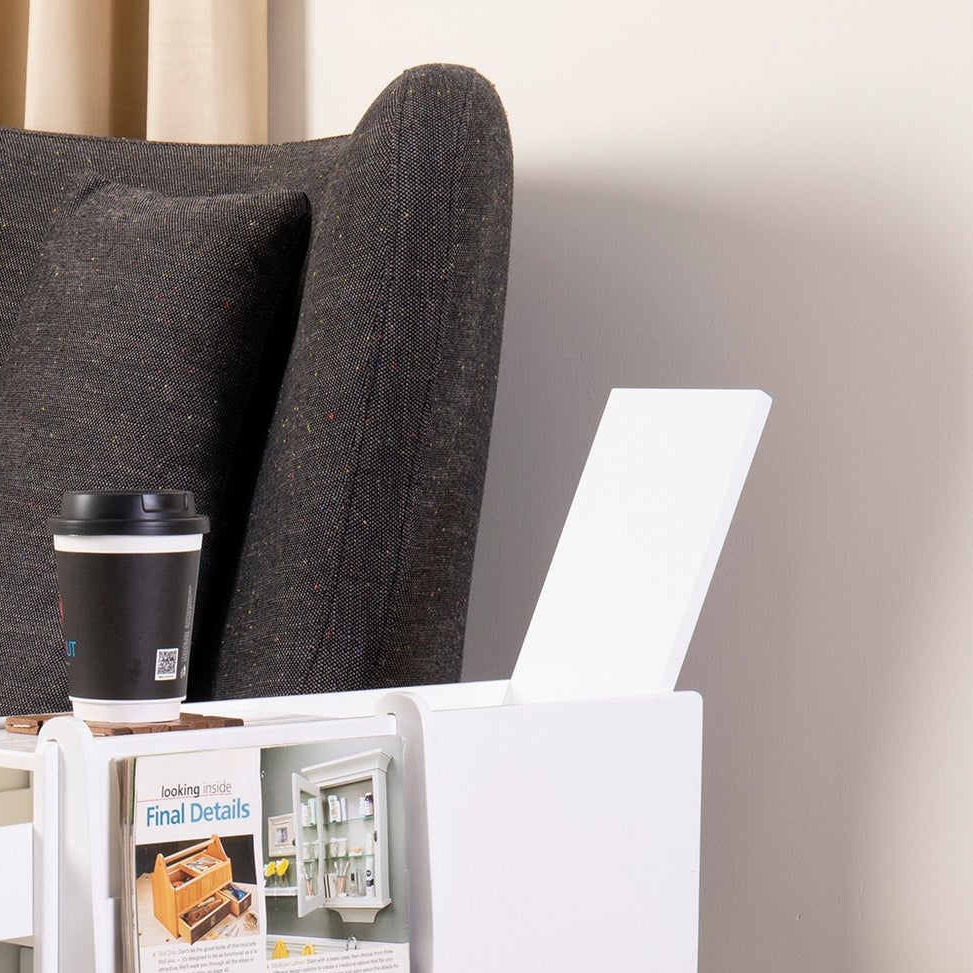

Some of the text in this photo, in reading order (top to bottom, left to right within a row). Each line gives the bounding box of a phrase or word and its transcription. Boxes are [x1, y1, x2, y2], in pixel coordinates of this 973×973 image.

[161, 781, 232, 798] looking inside
[146, 798, 250, 827] Final Details
